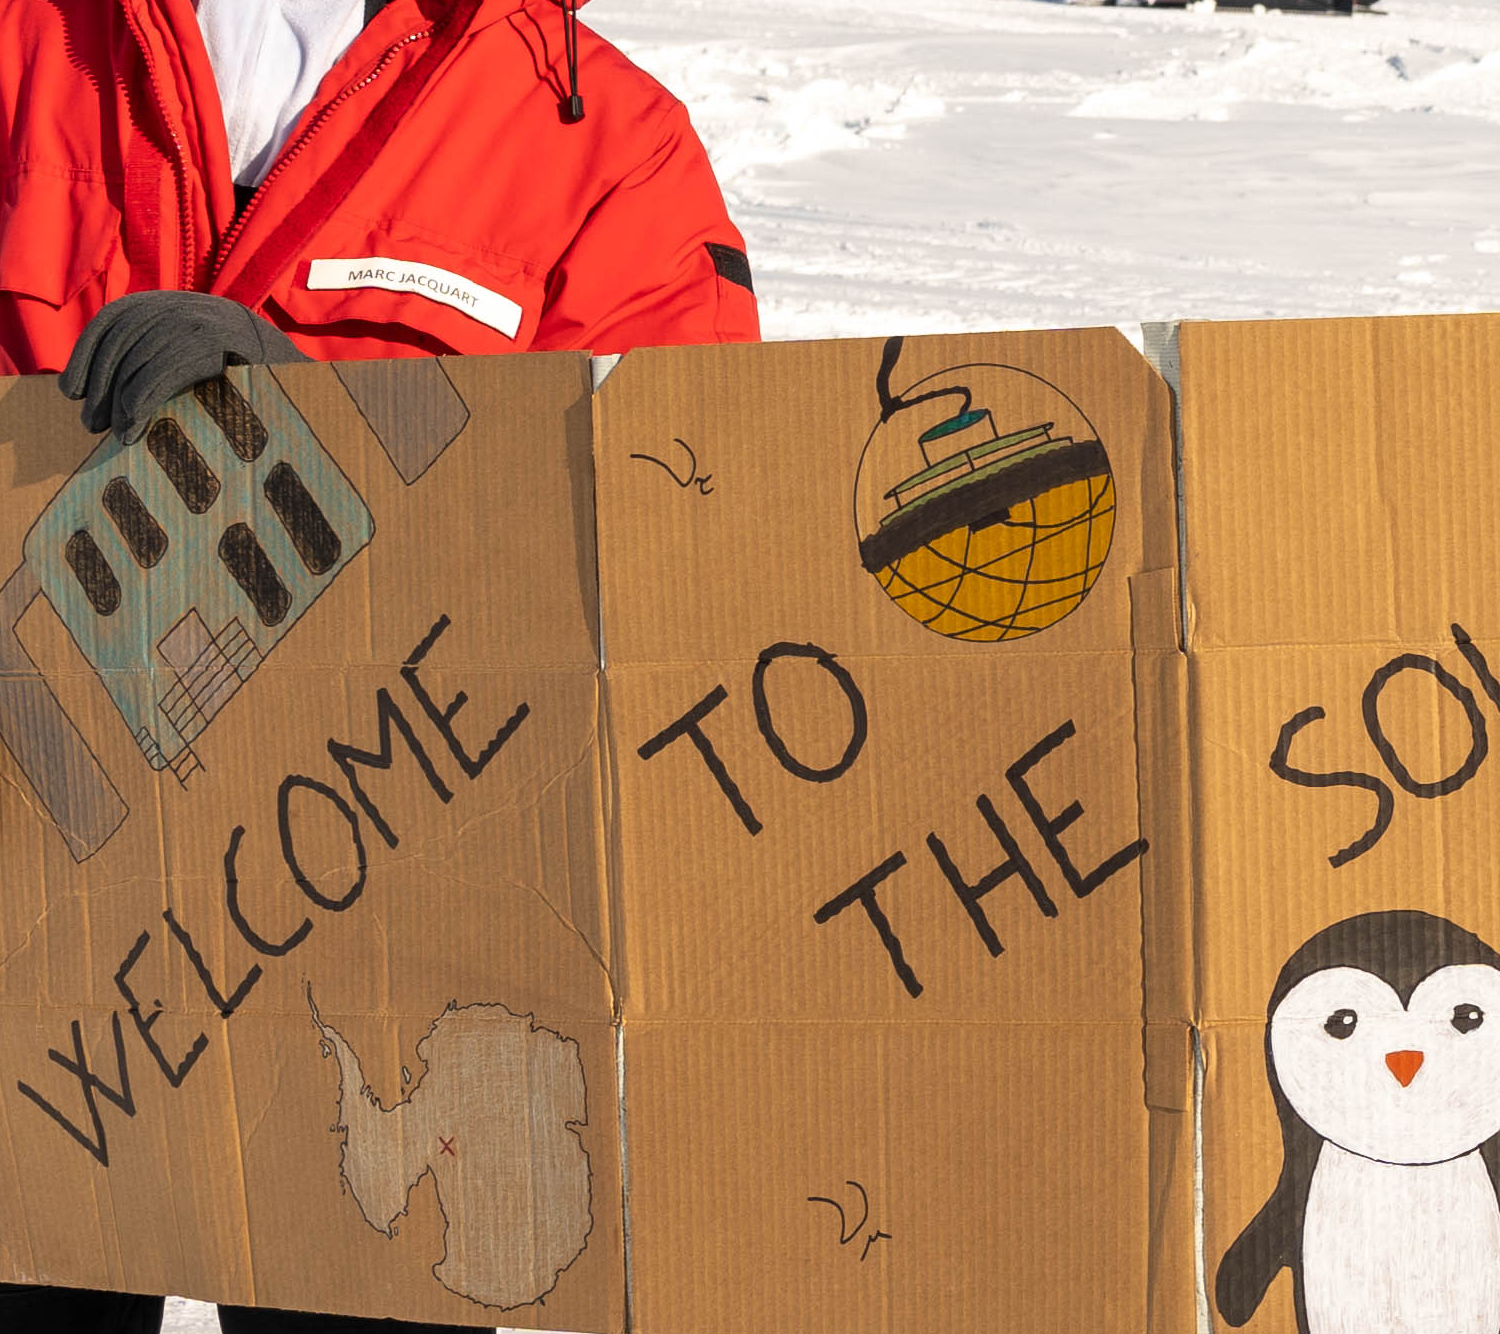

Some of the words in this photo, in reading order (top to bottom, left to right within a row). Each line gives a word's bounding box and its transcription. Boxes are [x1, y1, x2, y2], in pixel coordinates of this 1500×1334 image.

[348, 269, 396, 283] MARC
[398, 273, 479, 308] JACQUART
[637, 641, 868, 836] TO
[17, 614, 531, 1168] WELCOME
[813, 719, 1150, 999] THE
